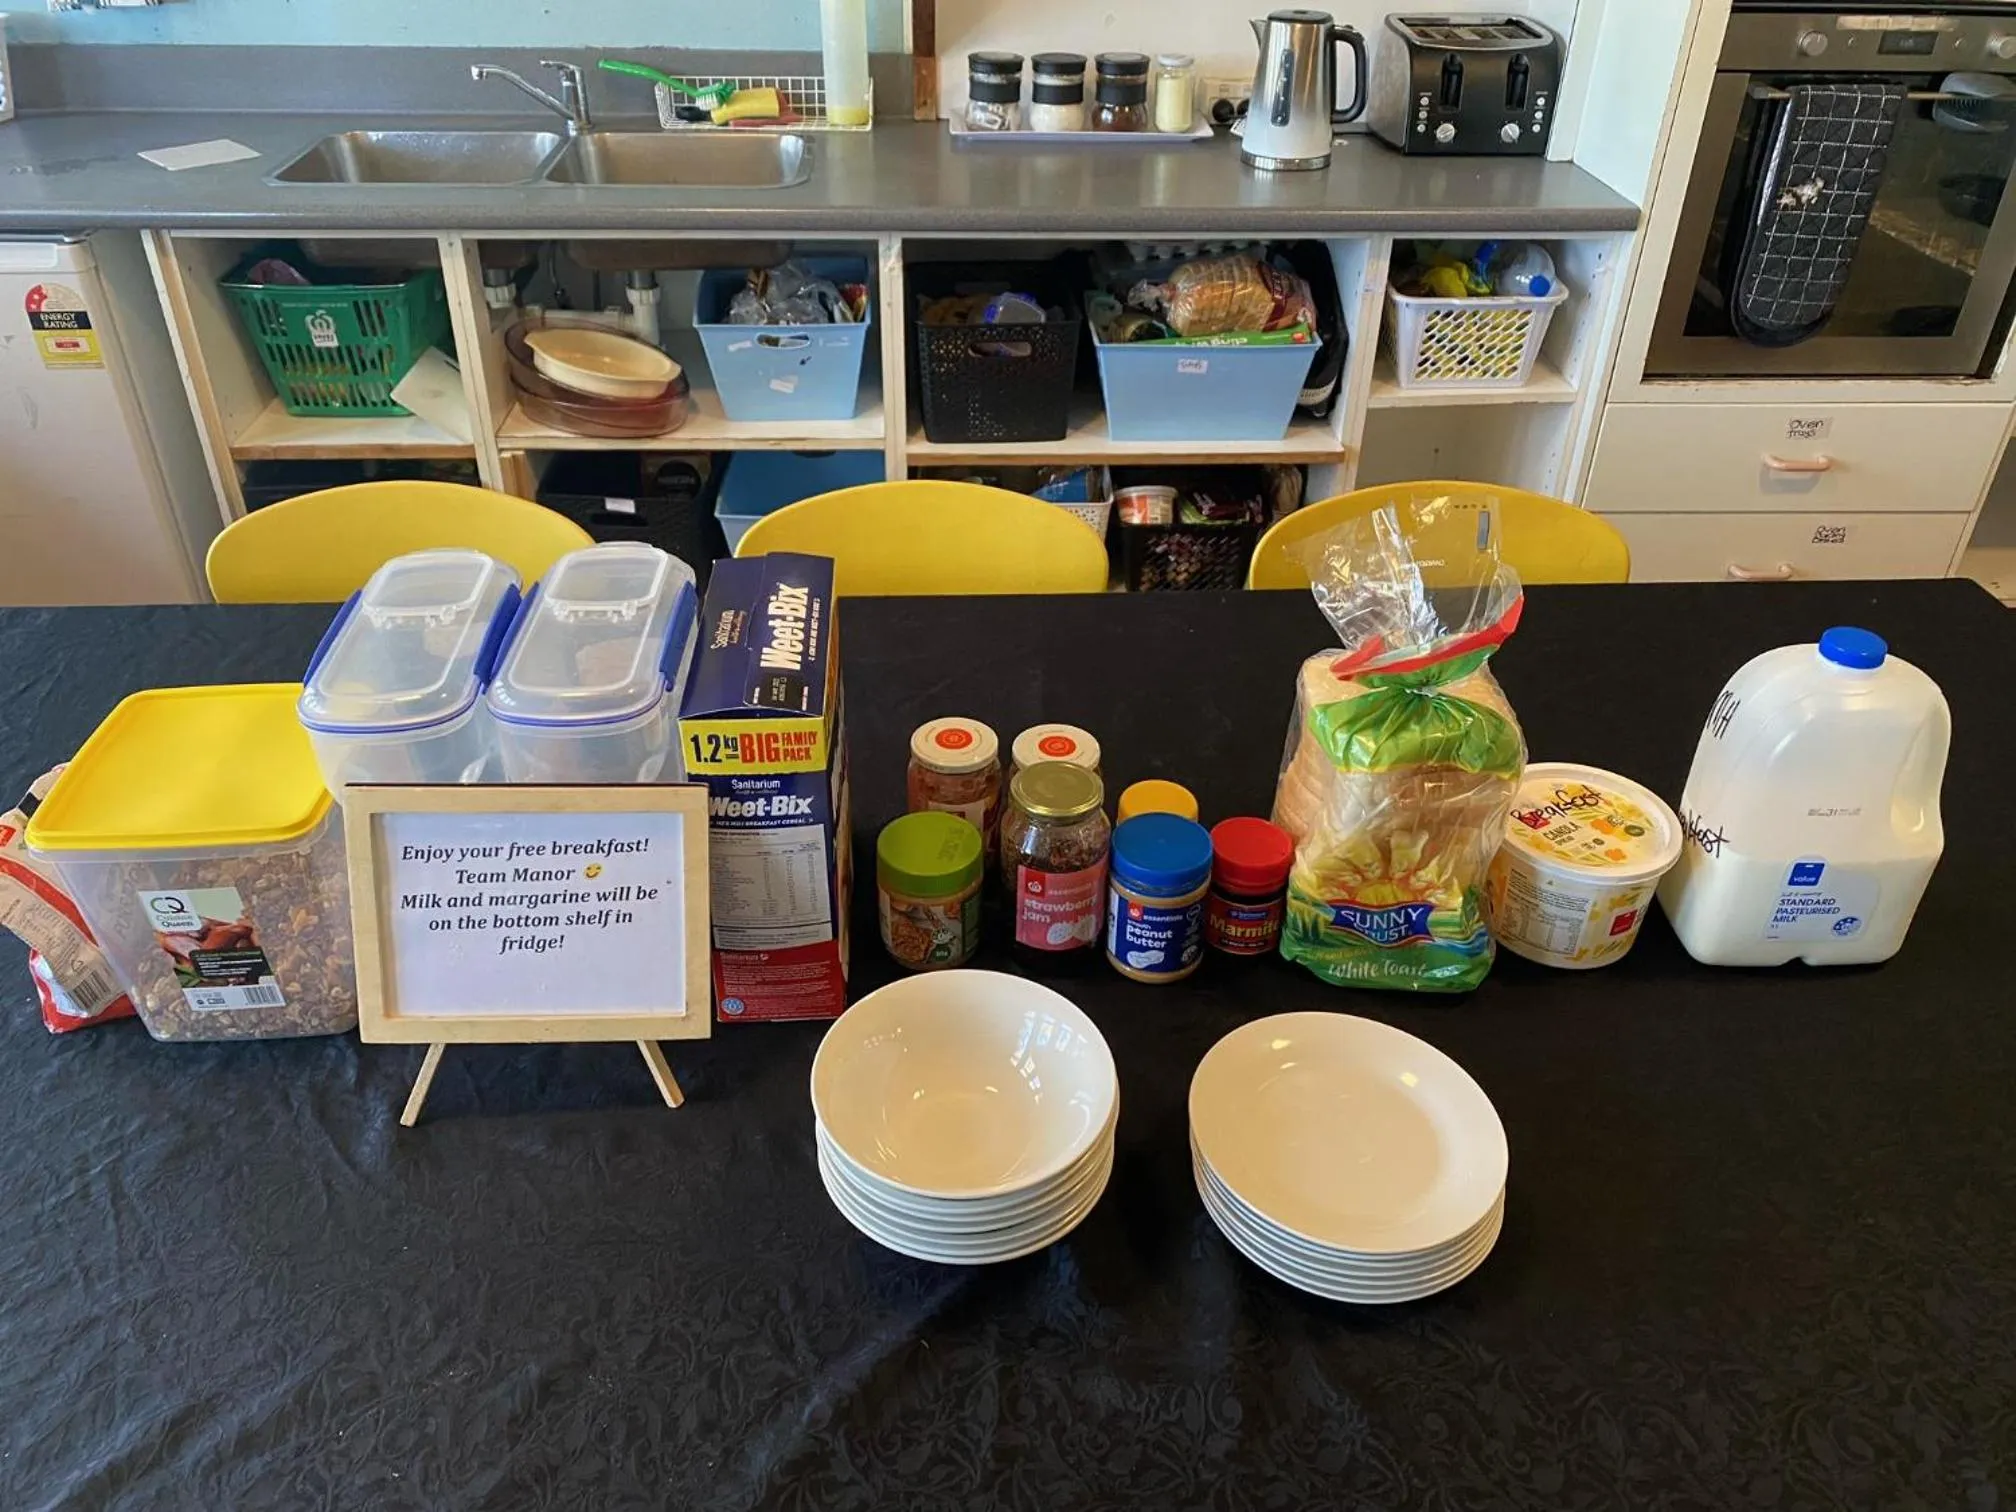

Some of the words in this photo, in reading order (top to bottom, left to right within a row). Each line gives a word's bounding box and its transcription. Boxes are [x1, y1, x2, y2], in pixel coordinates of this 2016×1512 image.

[40, 312, 75, 321] ENERGY
[43, 321, 78, 329] RATING
[760, 582, 809, 671] Weet-Bix
[782, 731, 818, 746] FAMILY
[739, 732, 781, 764] BIG
[783, 747, 812, 761] PACK
[732, 779, 780, 790] Sanitarium
[1510, 785, 1603, 829] Breakfast
[745, 819, 781, 827] BREAKFAST
[1543, 820, 1584, 841] CANOLA
[401, 845, 454, 864] Enjoy
[457, 847, 504, 862] your
[507, 842, 546, 860] free
[551, 838, 650, 858] breakfast!
[456, 869, 506, 884] Team
[512, 868, 576, 883] Manor
[1793, 874, 1817, 883] value
[401, 893, 442, 909] Milk
[447, 892, 483, 908] and
[488, 890, 591, 910] margarine
[596, 886, 630, 902] will
[636, 885, 658, 900] be
[1024, 894, 1097, 912] strawberry
[1779, 898, 1836, 906] STANDARD
[1022, 908, 1050, 923] jam
[1340, 907, 1424, 929] SUNNY
[1775, 906, 1841, 915] PASTEURISED
[429, 917, 451, 930] on
[458, 915, 487, 930] the
[493, 913, 560, 929] bottom
[565, 910, 611, 928] shelf
[615, 910, 633, 924] in
[1773, 914, 1798, 923] MILK
[1126, 925, 1173, 940] peanut
[499, 934, 565, 955] fridge!
[1126, 934, 1167, 949] butter
